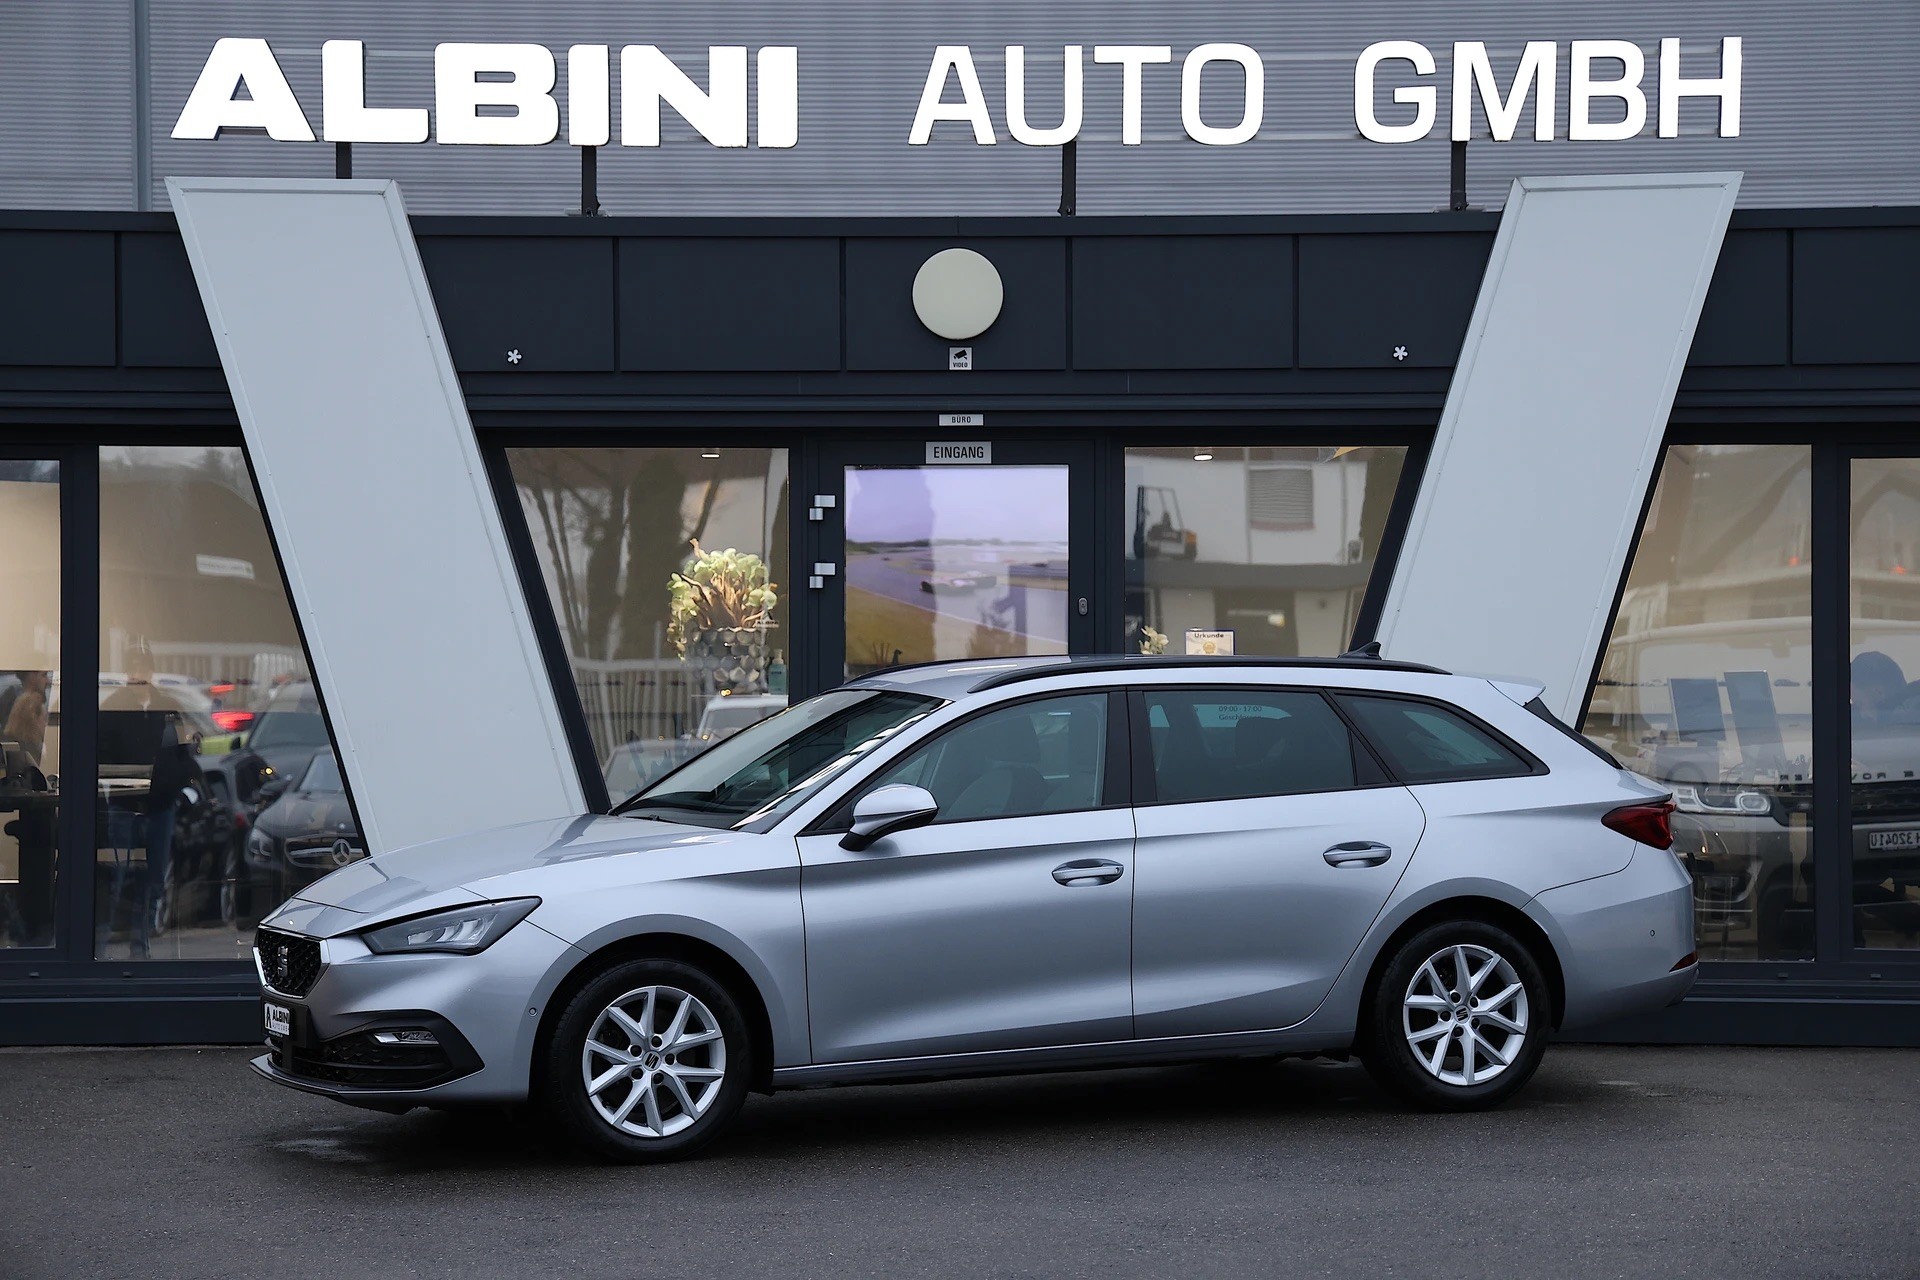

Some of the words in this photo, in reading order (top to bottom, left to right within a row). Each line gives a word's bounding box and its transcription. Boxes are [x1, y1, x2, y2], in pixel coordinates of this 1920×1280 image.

[170, 37, 799, 148] ALBINI
[907, 44, 1264, 146] AUTO
[1354, 36, 1743, 142] GMBH
[951, 414, 972, 424] BÜRO
[933, 446, 984, 459] EINGANG
